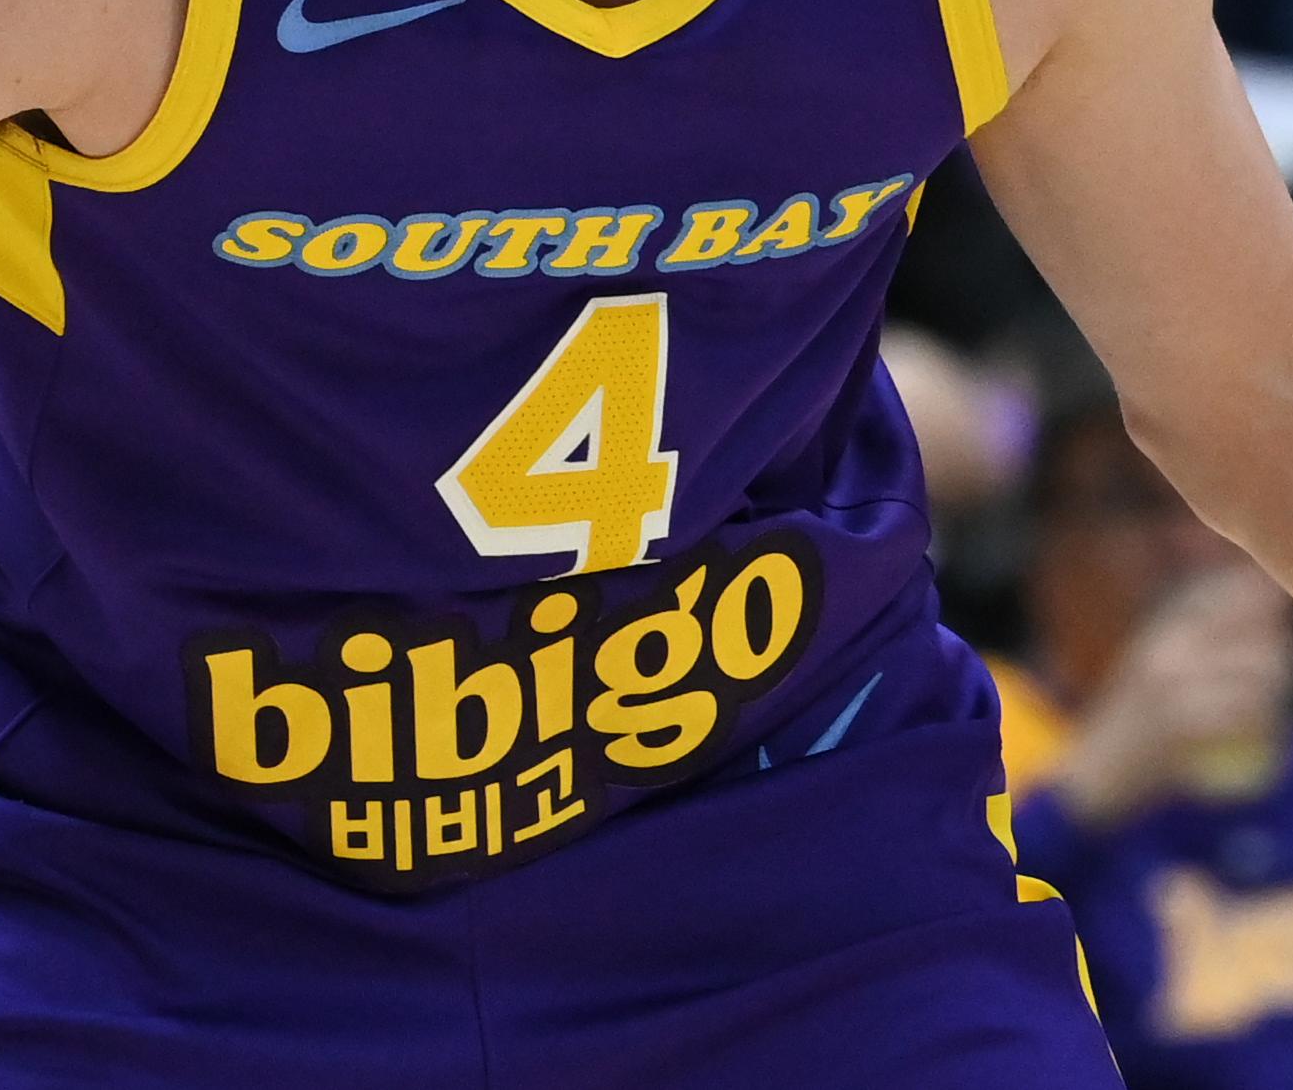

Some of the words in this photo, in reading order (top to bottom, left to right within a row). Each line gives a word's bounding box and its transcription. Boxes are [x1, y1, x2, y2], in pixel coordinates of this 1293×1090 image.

[213, 207, 663, 280] SOUTH
[656, 173, 913, 272] BAY
[434, 292, 679, 581] 4
[205, 552, 804, 785] bibigo
[330, 748, 586, 871] 비비고
